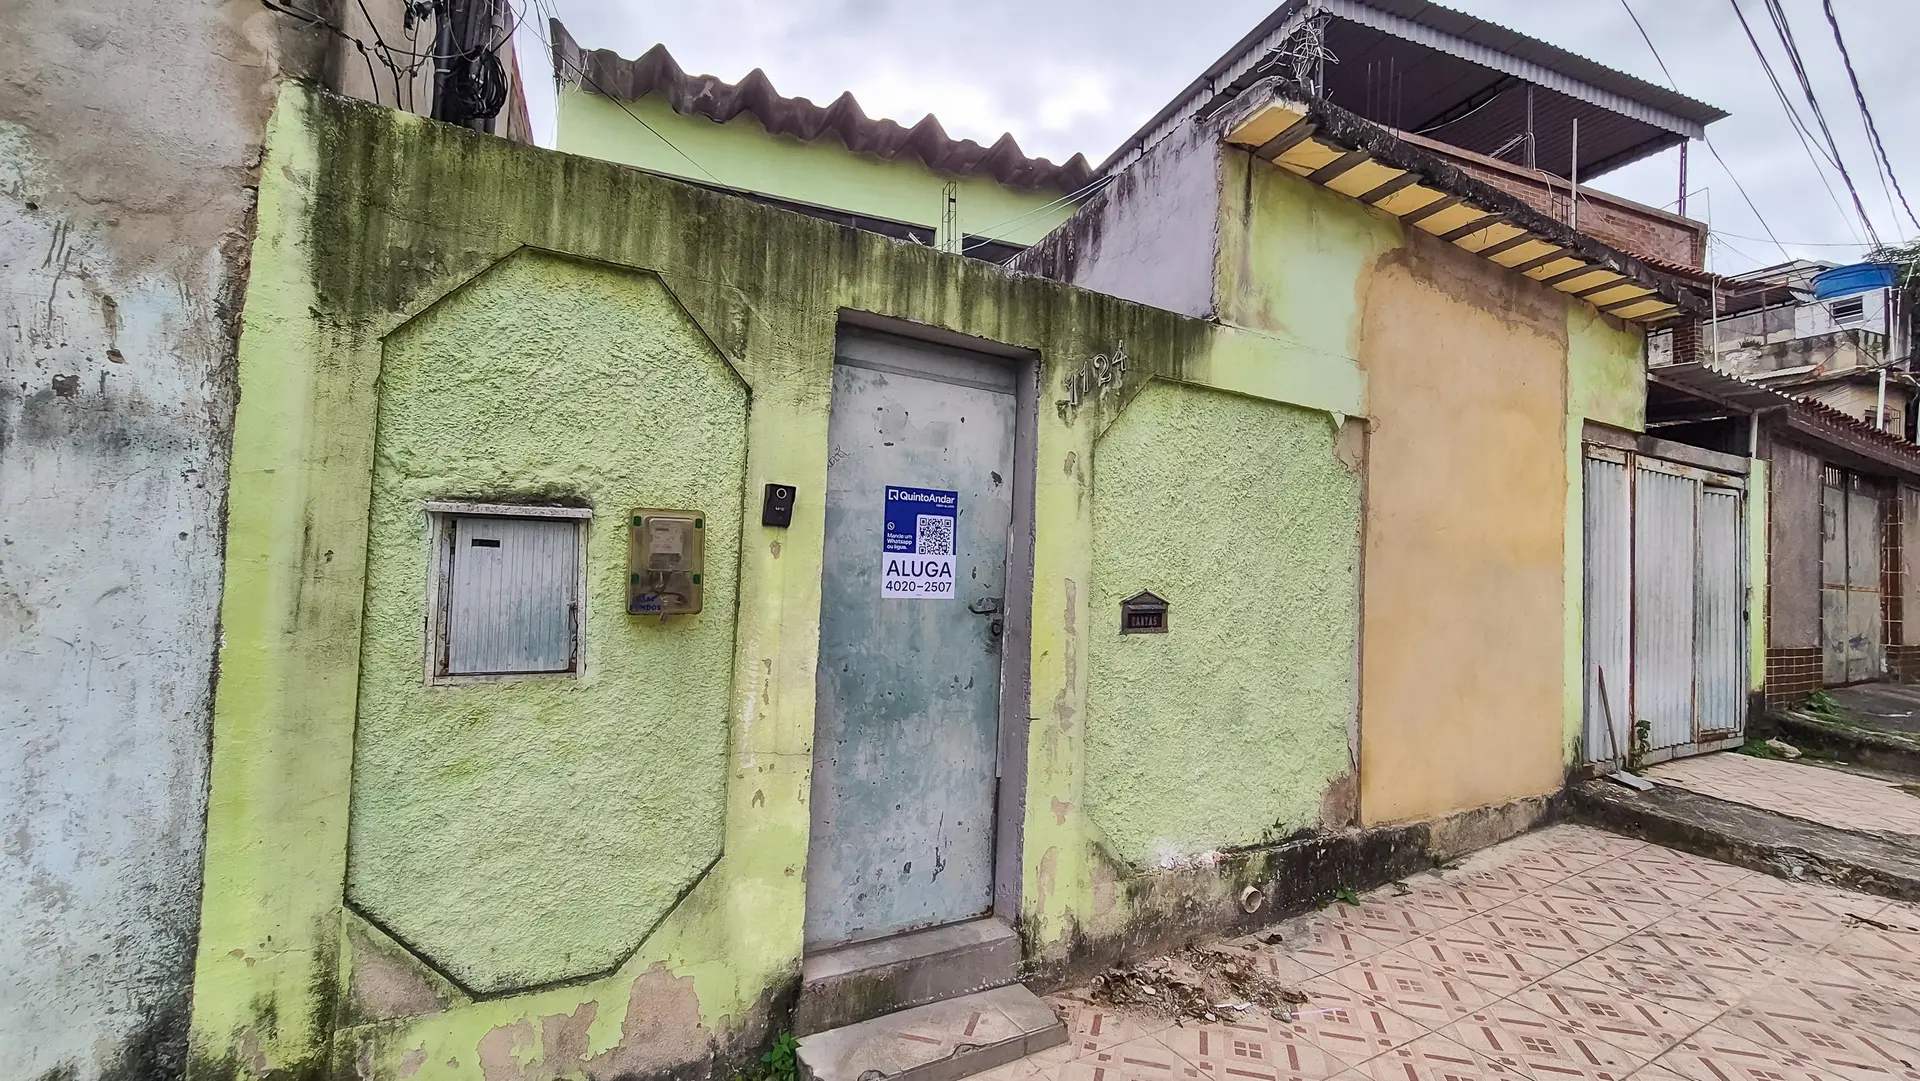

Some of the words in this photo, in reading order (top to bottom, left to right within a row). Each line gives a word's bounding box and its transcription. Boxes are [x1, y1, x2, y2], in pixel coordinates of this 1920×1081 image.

[1064, 340, 1127, 405] 1124
[900, 491, 955, 504] QuintoAndar
[886, 560, 952, 578] ALUGA
[885, 580, 952, 592] 4020-2507
